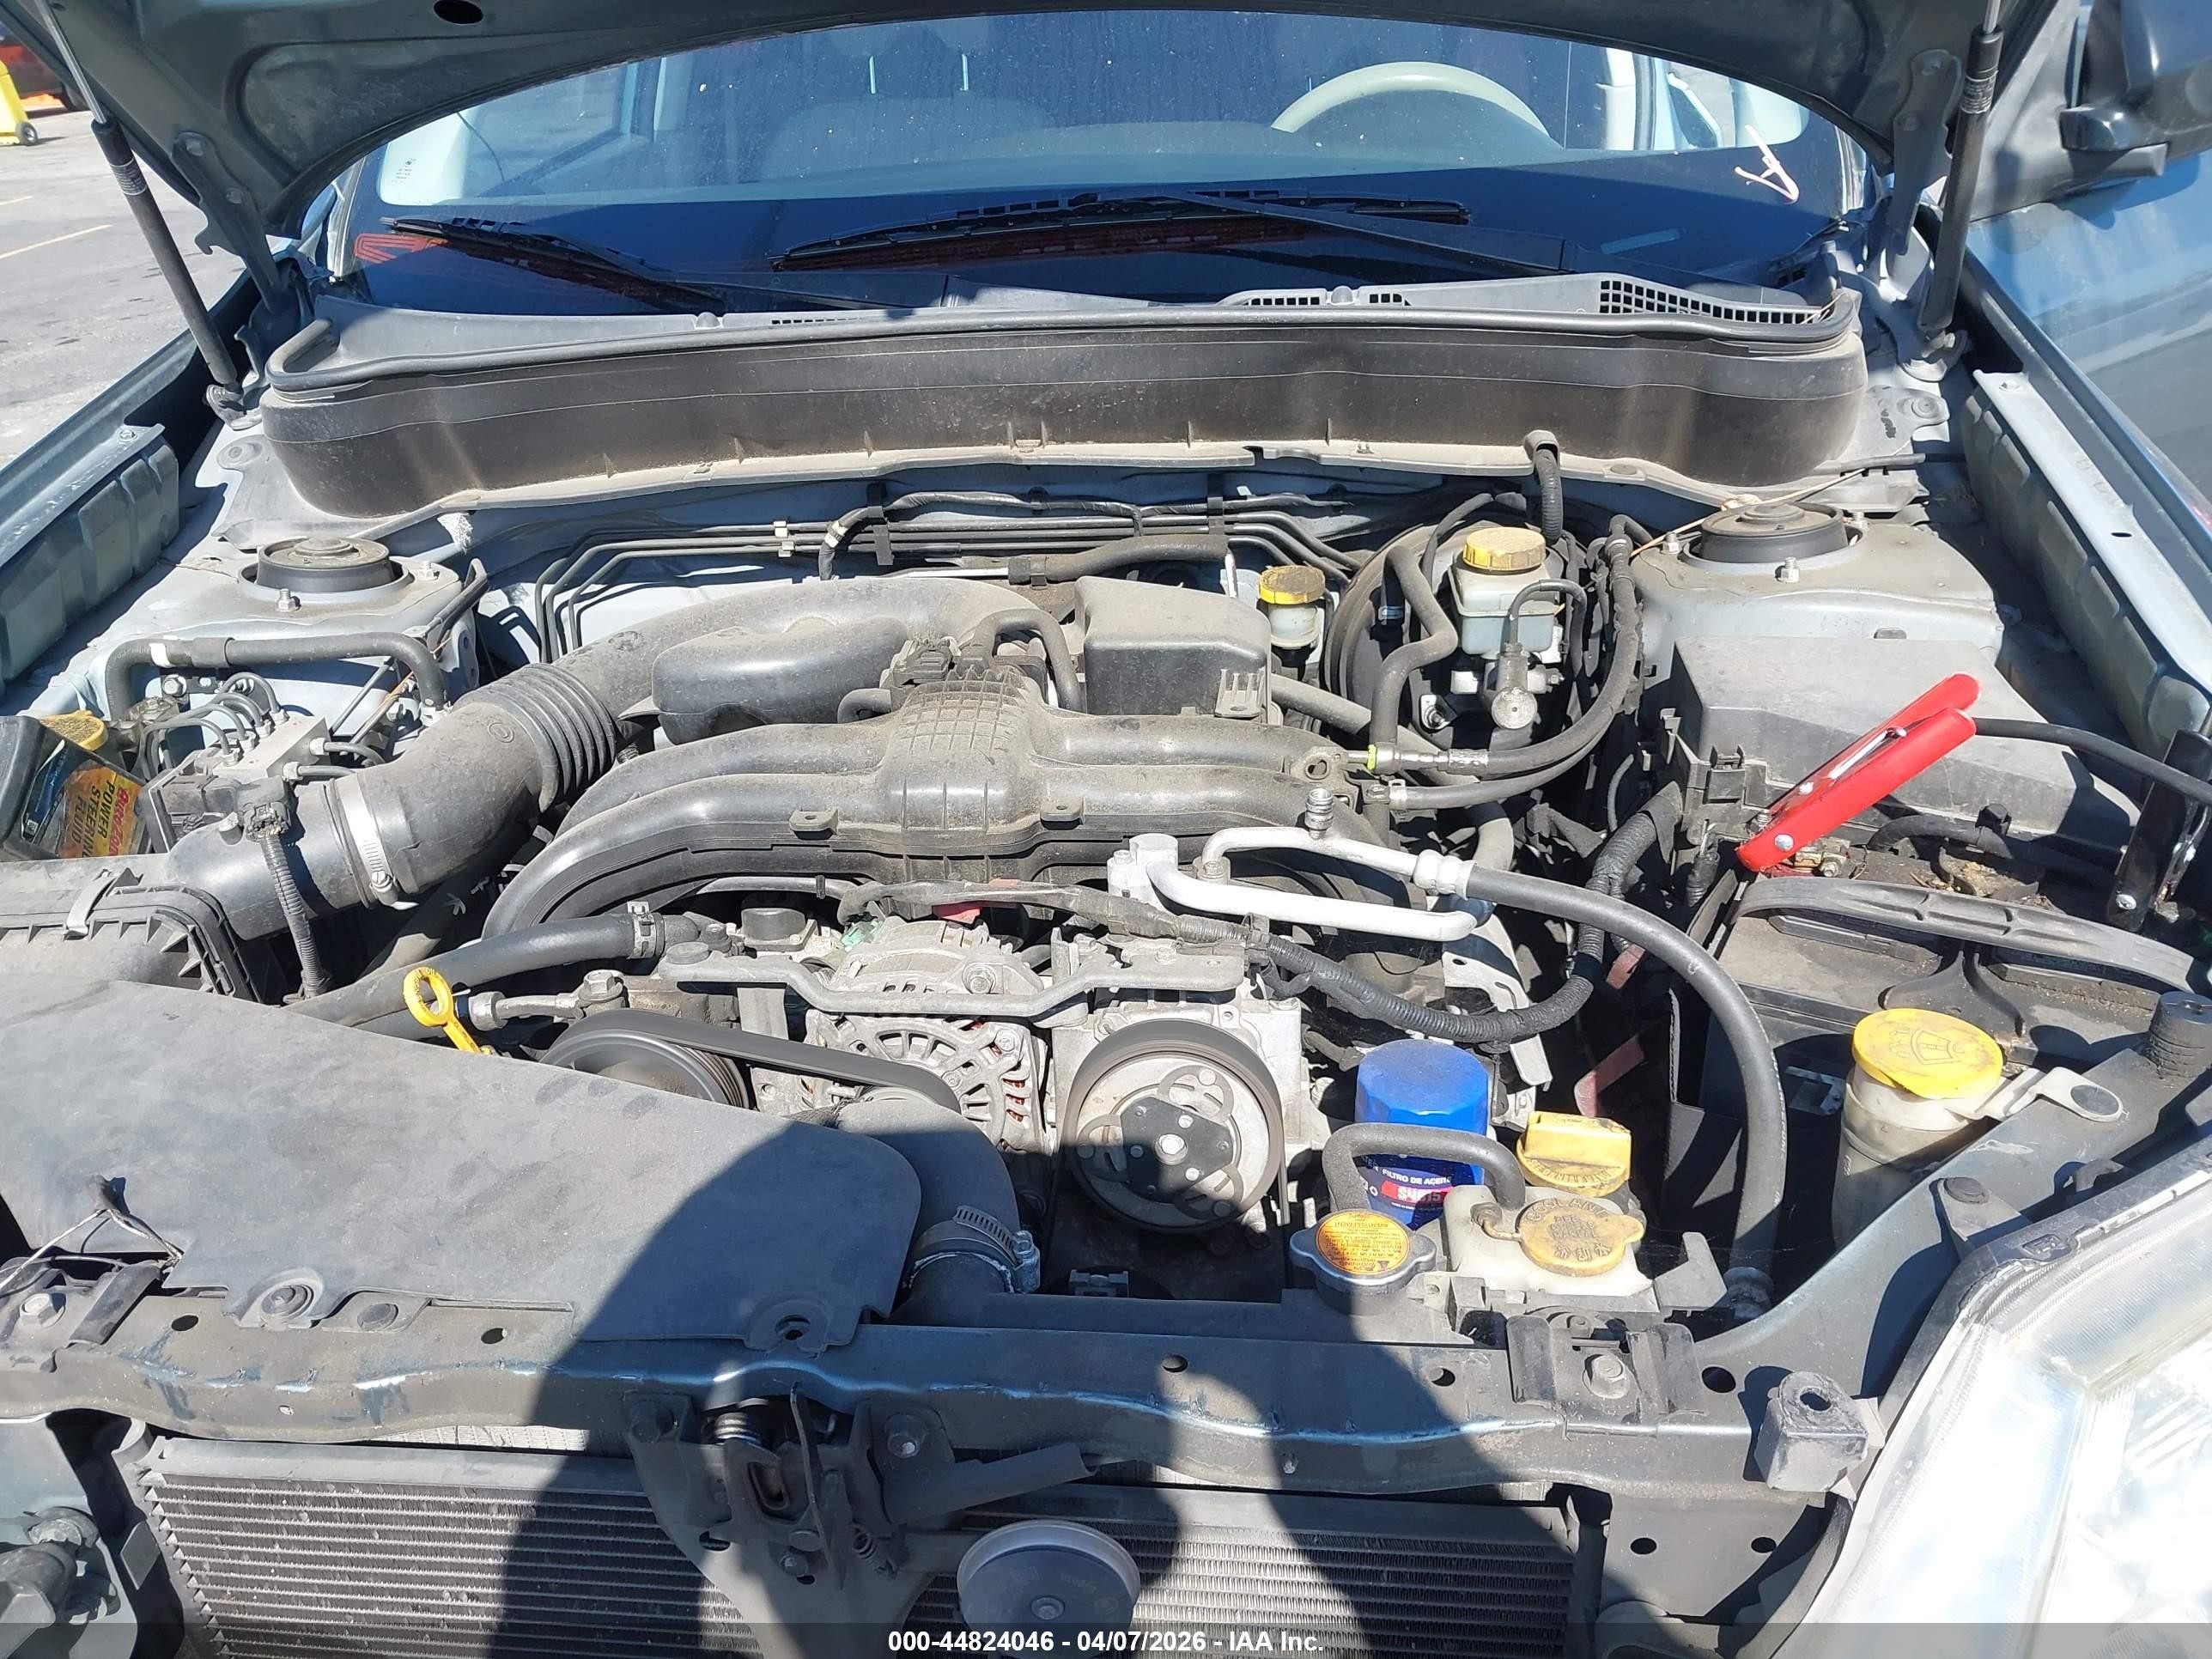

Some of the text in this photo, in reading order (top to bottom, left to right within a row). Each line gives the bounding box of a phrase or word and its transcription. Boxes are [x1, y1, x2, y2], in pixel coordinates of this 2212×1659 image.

[71, 795, 87, 844] FLUID
[98, 780, 115, 839] POWER
[110, 787, 130, 856] AutoZon
[1382, 1169, 1409, 1182] FILTRO
[1410, 1176, 1423, 1185] DE
